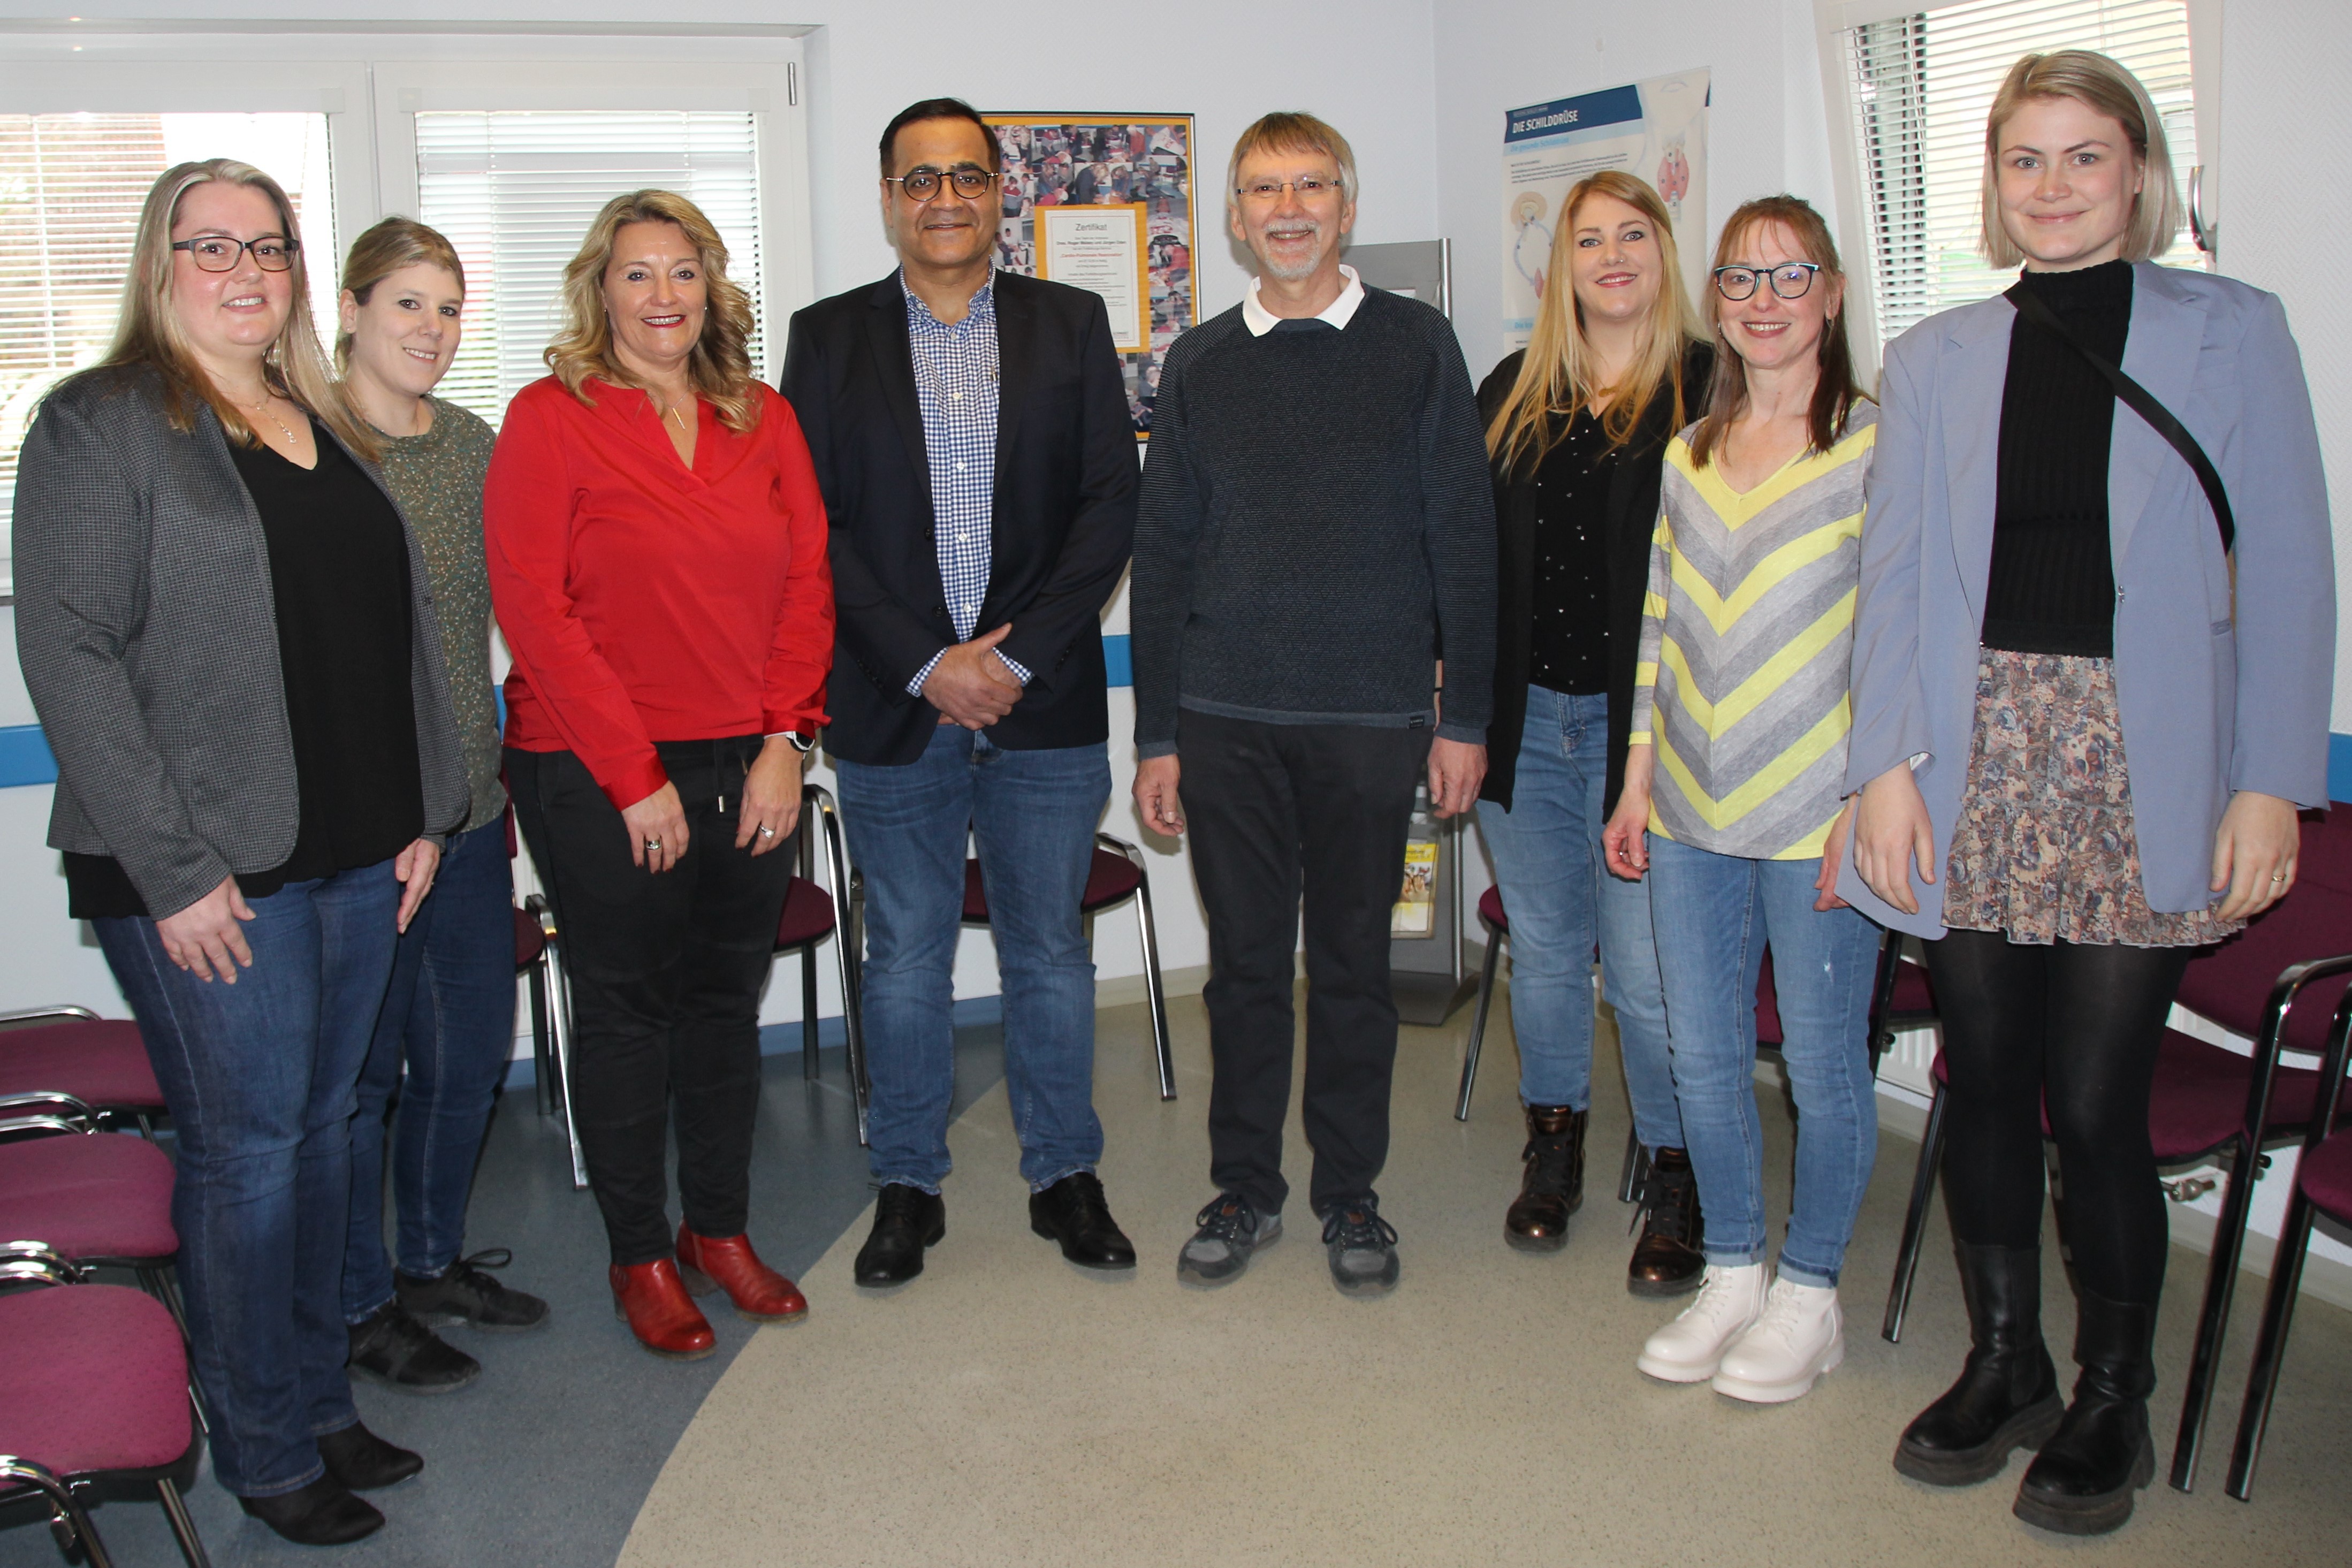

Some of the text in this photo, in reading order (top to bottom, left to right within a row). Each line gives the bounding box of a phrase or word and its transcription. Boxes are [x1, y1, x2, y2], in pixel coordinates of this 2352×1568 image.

[1512, 120, 1525, 134] DIE
[1526, 110, 1578, 131] SCHILDDRÜSE
[1075, 223, 1107, 231] Zertifikat
